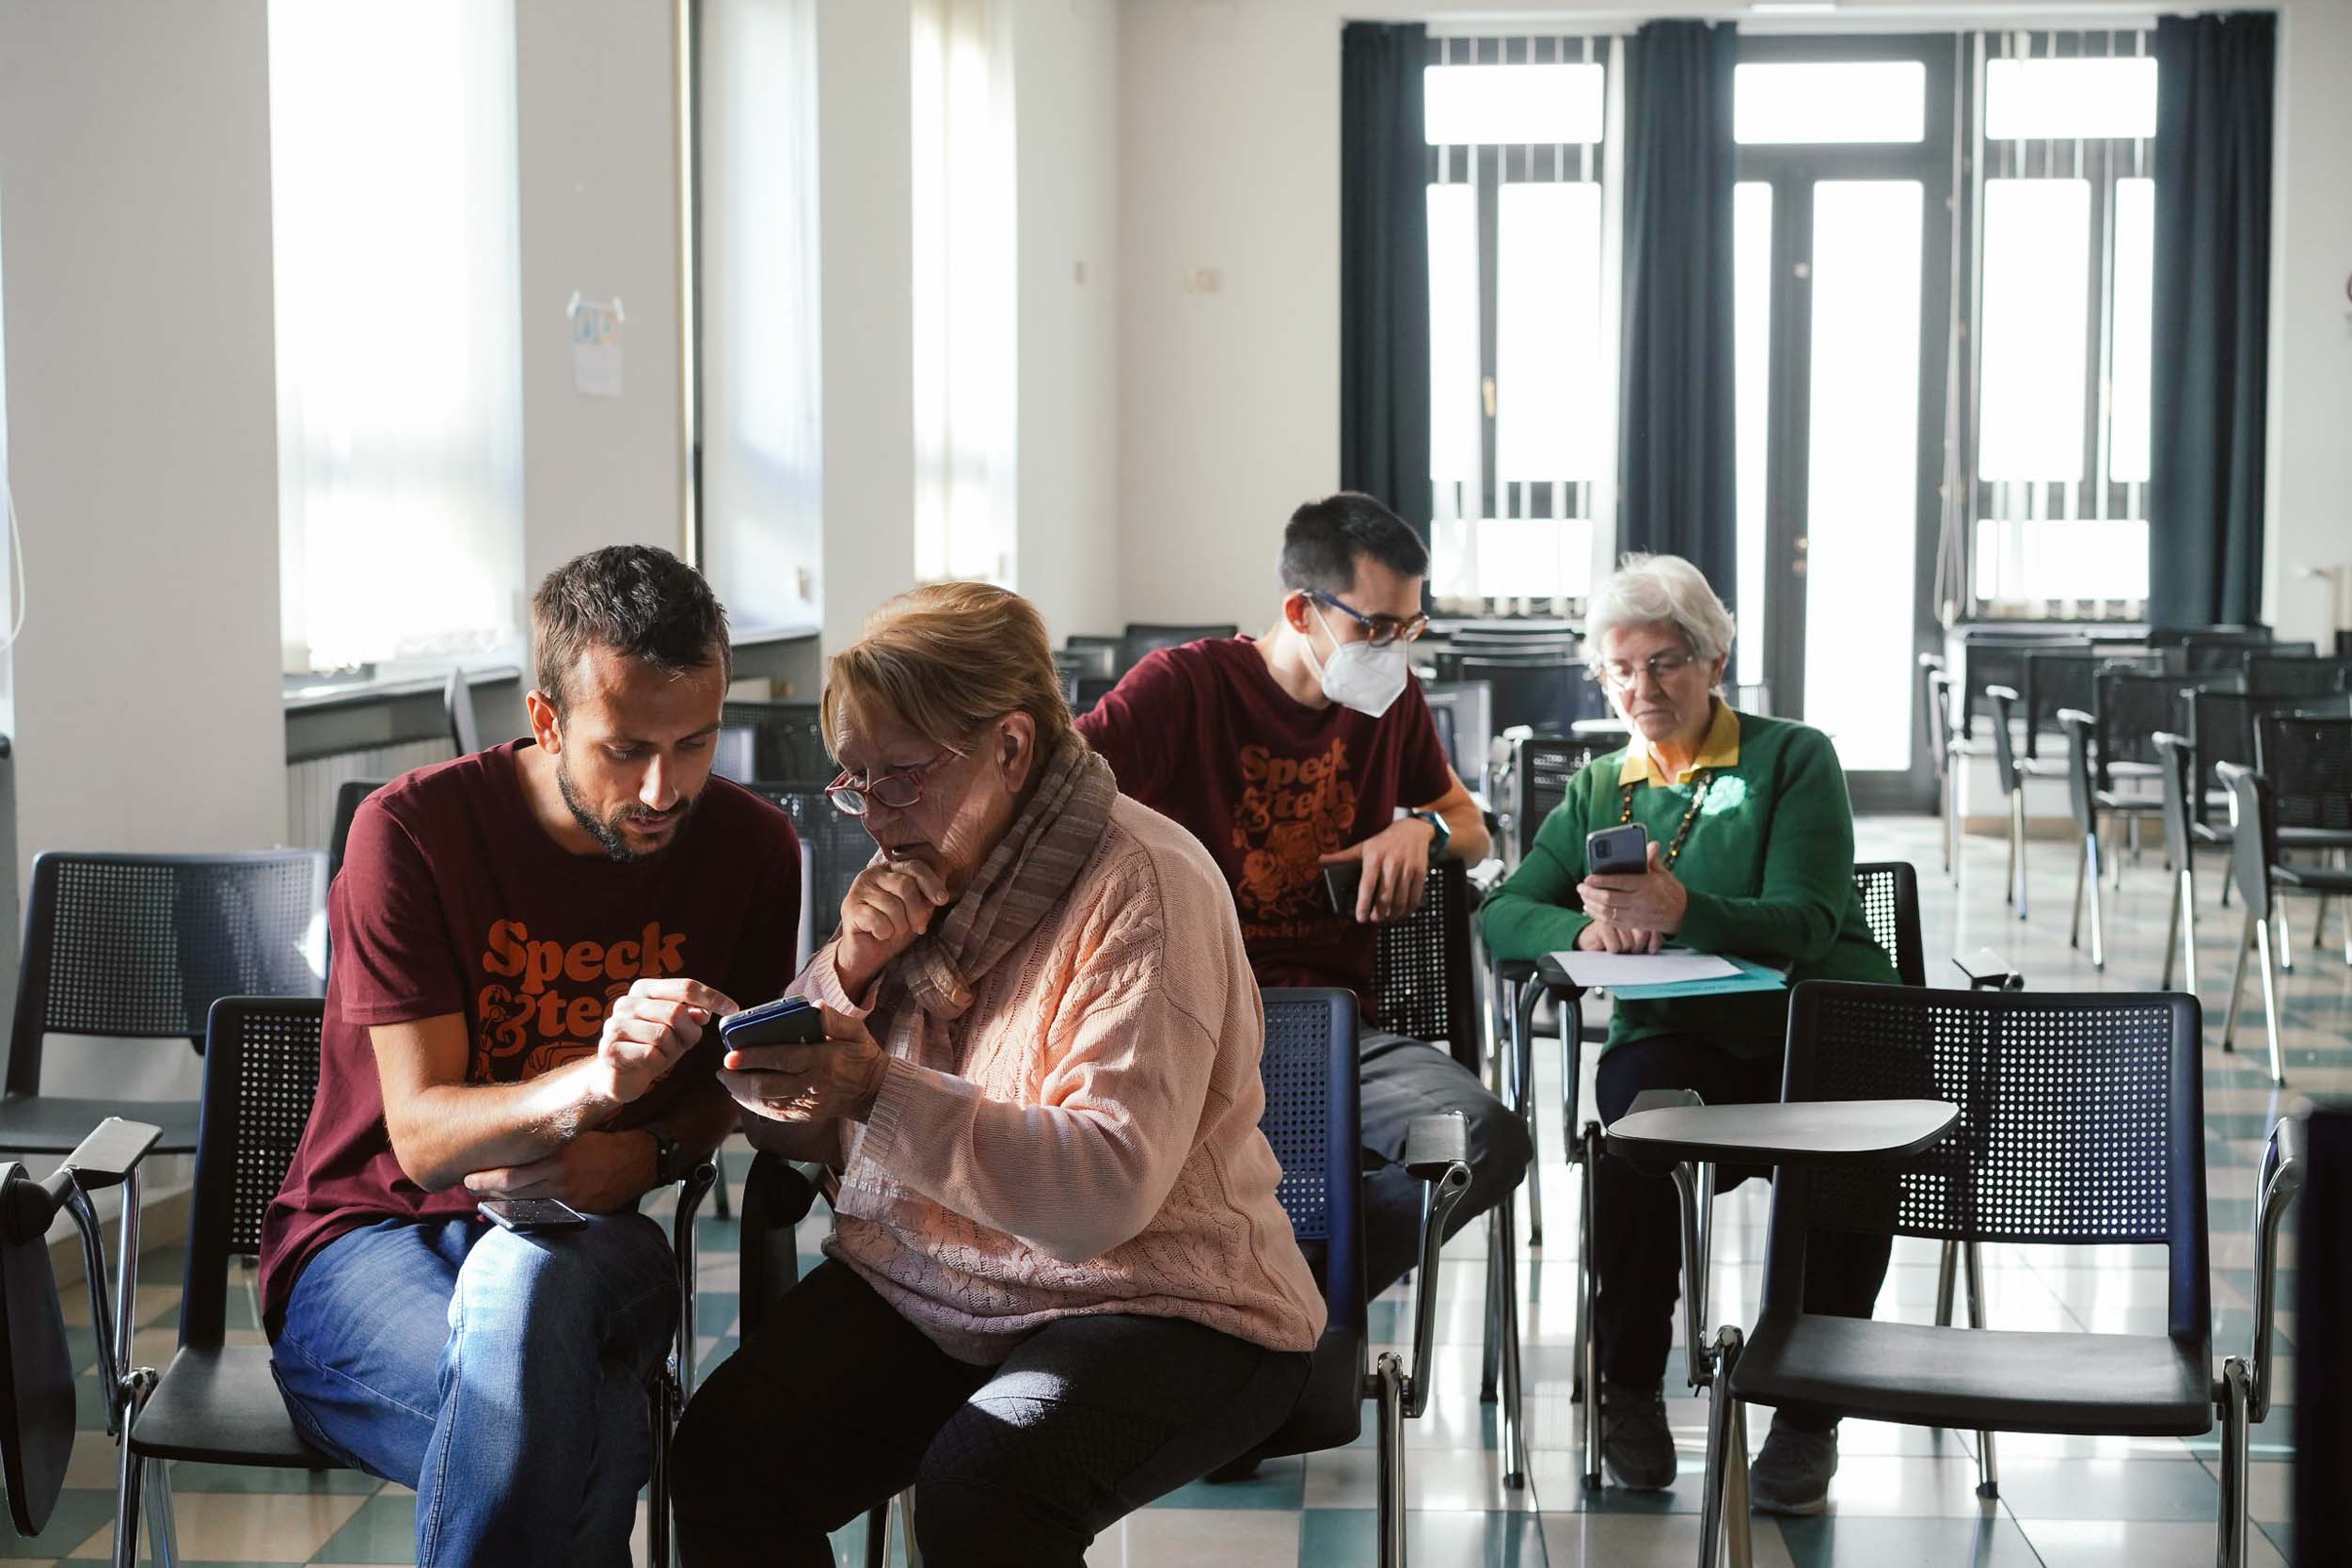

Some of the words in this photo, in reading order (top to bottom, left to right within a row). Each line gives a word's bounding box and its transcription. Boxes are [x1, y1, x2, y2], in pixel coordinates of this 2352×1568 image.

[1240, 737, 1348, 790] Speck
[482, 918, 686, 994] Speck
[478, 984, 536, 1057] &
[536, 990, 615, 1037] te
